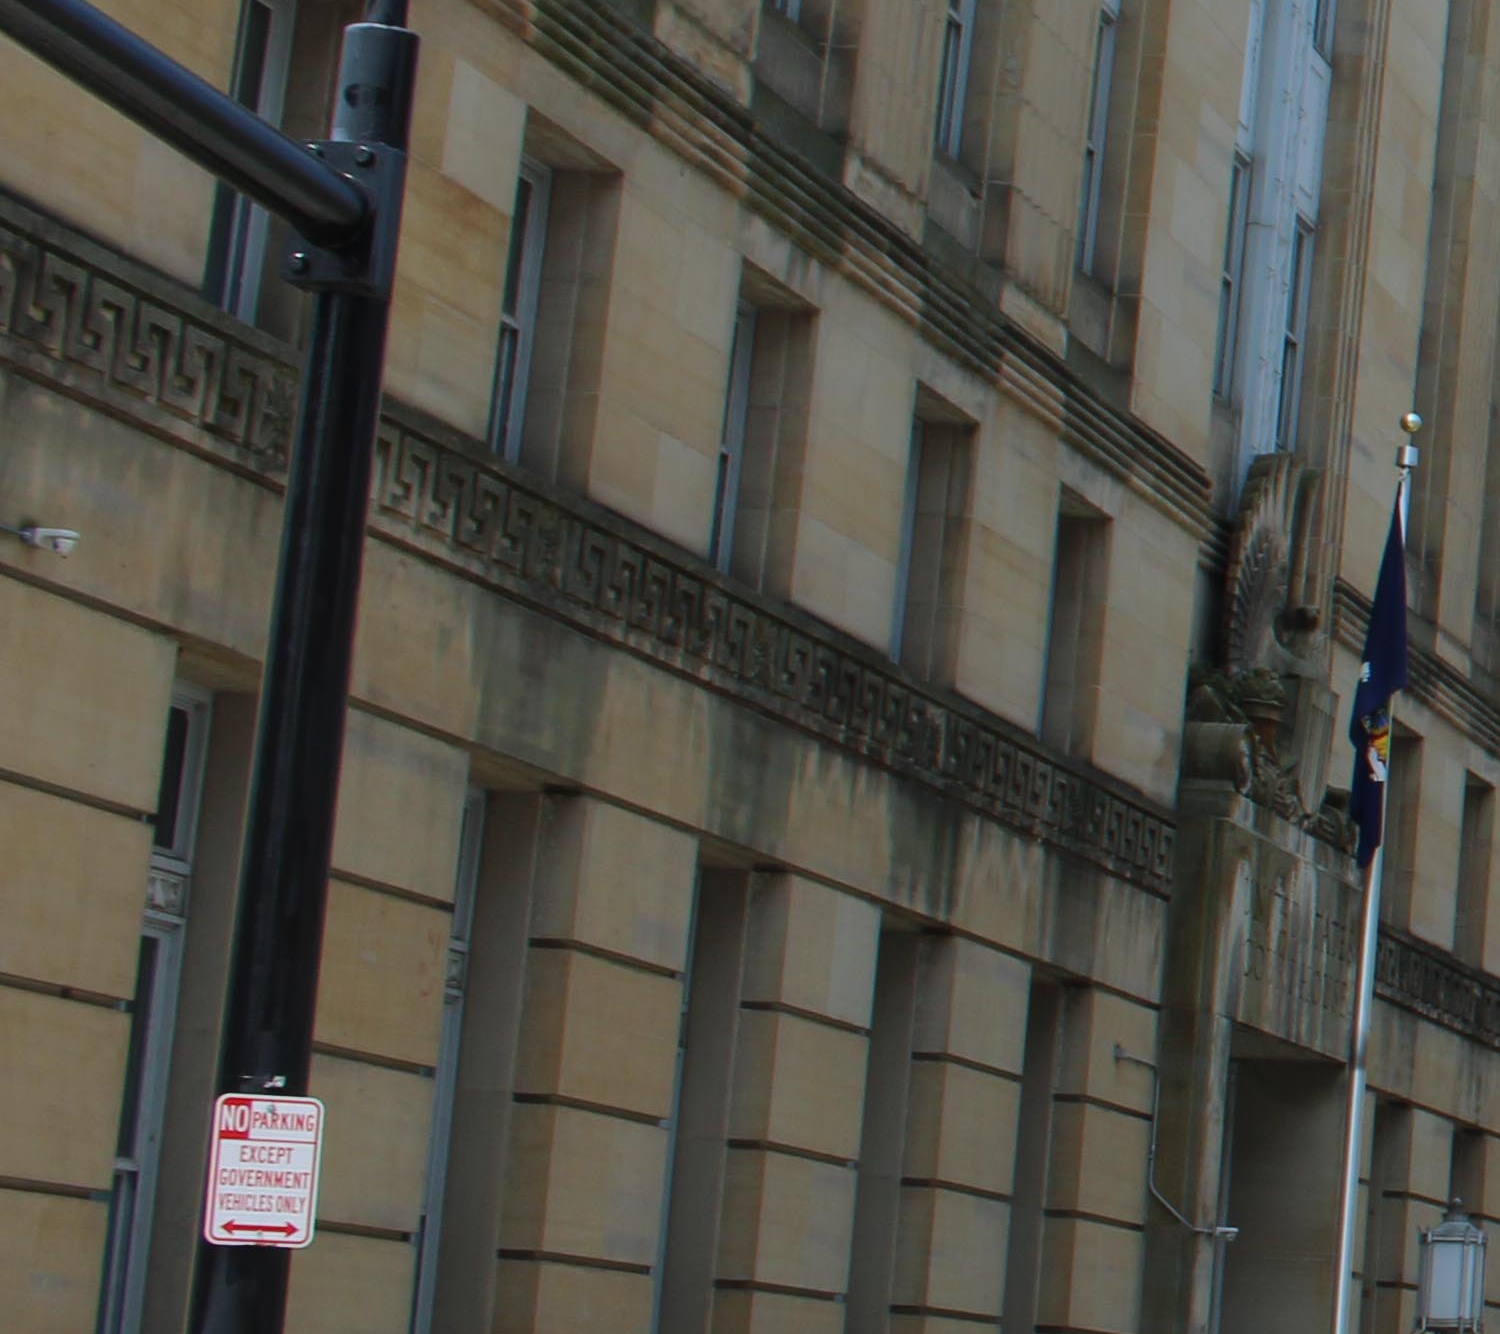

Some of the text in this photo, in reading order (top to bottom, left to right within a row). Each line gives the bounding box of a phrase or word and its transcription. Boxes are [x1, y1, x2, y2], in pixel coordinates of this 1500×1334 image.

[220, 1104, 315, 1133] NO PARKING
[240, 1144, 294, 1165] EXCEPT
[219, 1168, 310, 1189] GOVERNMENT
[218, 1193, 307, 1214] VEHICLES ONLY
